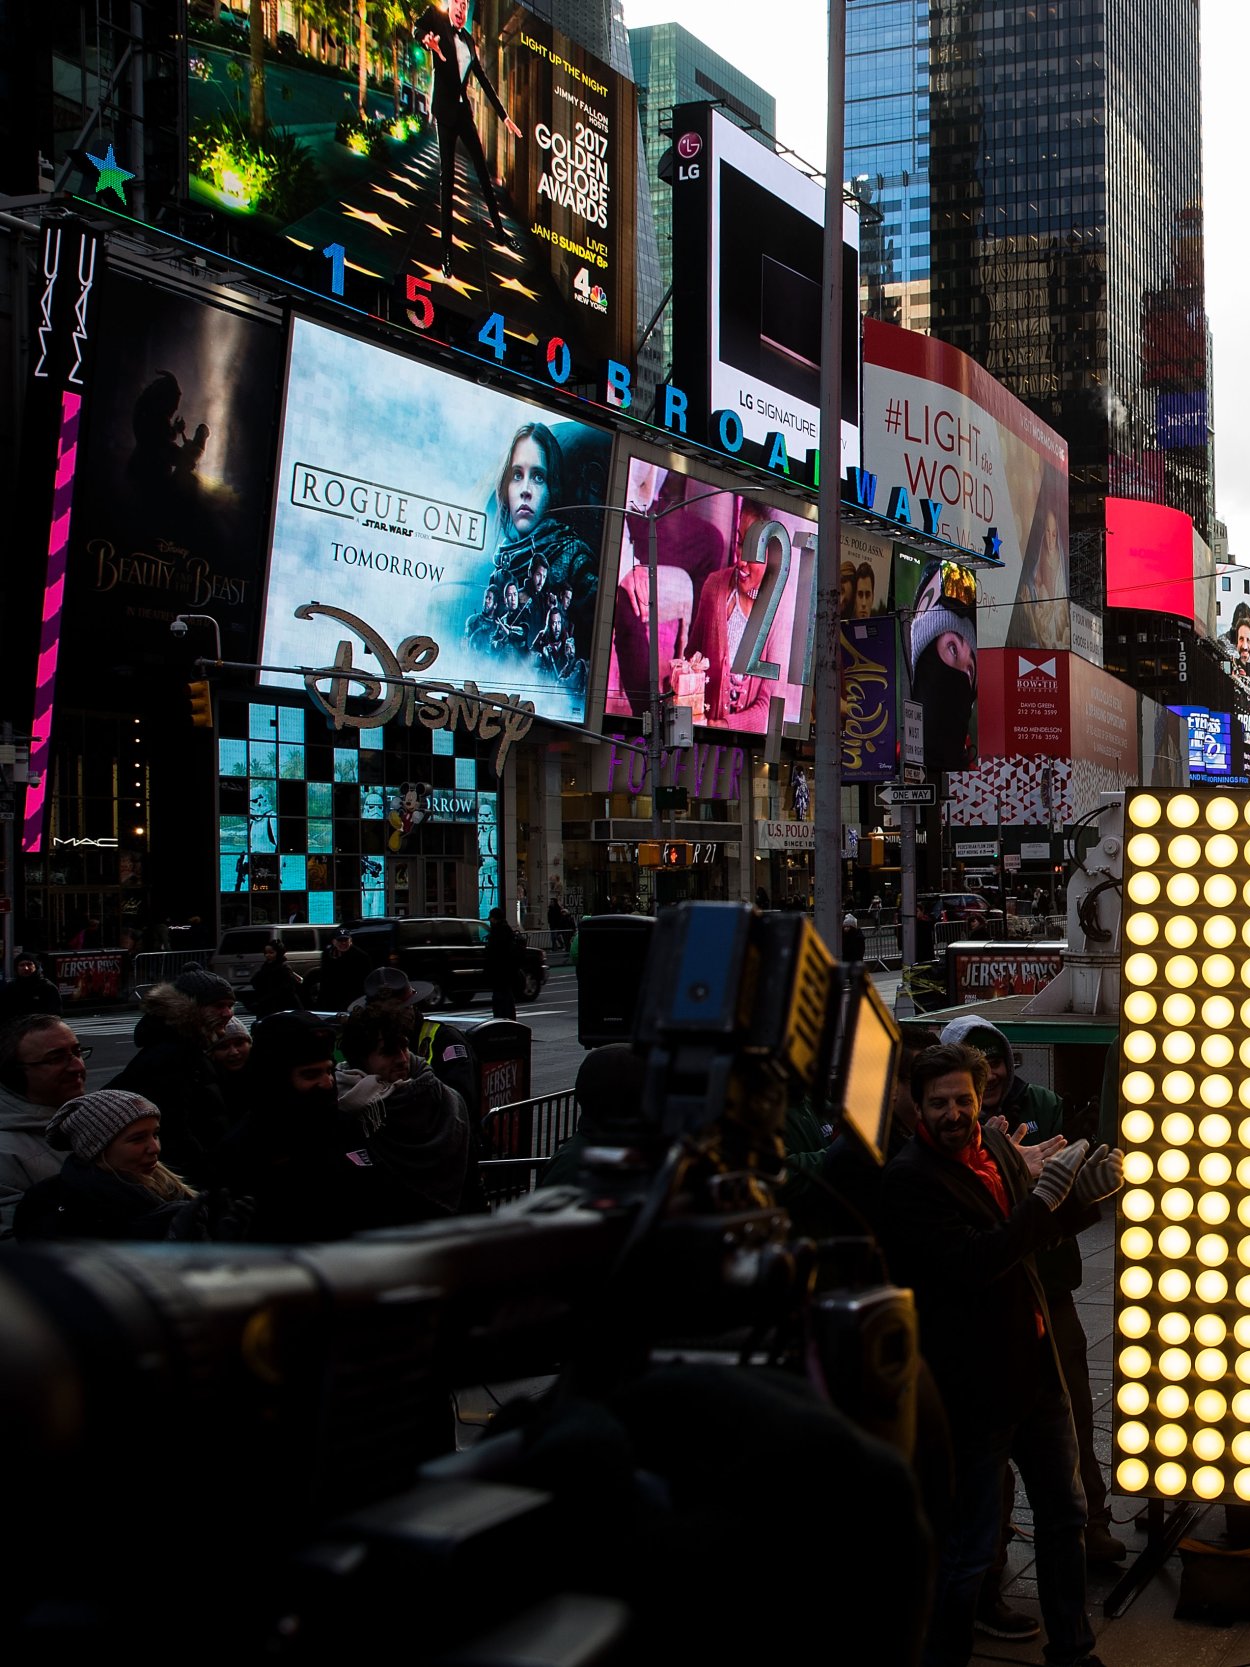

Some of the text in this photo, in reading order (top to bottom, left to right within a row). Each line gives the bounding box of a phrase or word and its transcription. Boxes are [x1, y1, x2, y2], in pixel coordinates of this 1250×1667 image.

[520, 32, 608, 97] LIGHT UP THE NIGHT
[554, 86, 609, 125] JIMMY FALLON
[575, 122, 608, 159] 2017
[588, 116, 609, 133] HOSTS
[535, 123, 608, 184] GOLDEN
[551, 157, 609, 208] GLOBE
[679, 164, 700, 181] LG
[538, 172, 608, 229] AWARDS
[531, 223, 608, 269] JAN 8 SUNDAY 8P
[586, 237, 608, 257] LIVE!
[574, 267, 591, 298] 4
[574, 293, 608, 314] NEW YORK
[740, 390, 816, 438] LG SIGNATURE
[884, 398, 993, 476] #LIGHT the
[302, 472, 479, 541] ROGUE ONE
[904, 453, 994, 523] WORLD
[362, 519, 388, 532] STAR
[388, 525, 414, 537] WARS
[331, 542, 445, 582] TOMORROW
[851, 539, 867, 551] POLO
[868, 544, 884, 558] ASSN.
[1178, 641, 1187, 682] 1500
[608, 731, 744, 800] FOEVER
[893, 791, 929, 800] ONE WAY
[768, 824, 810, 838] U.S. POLO
[703, 844, 717, 863] 21
[58, 959, 95, 978] JERSEY
[961, 962, 1058, 987] JERSEY BOYS
[485, 1062, 518, 1096] JERSEY
